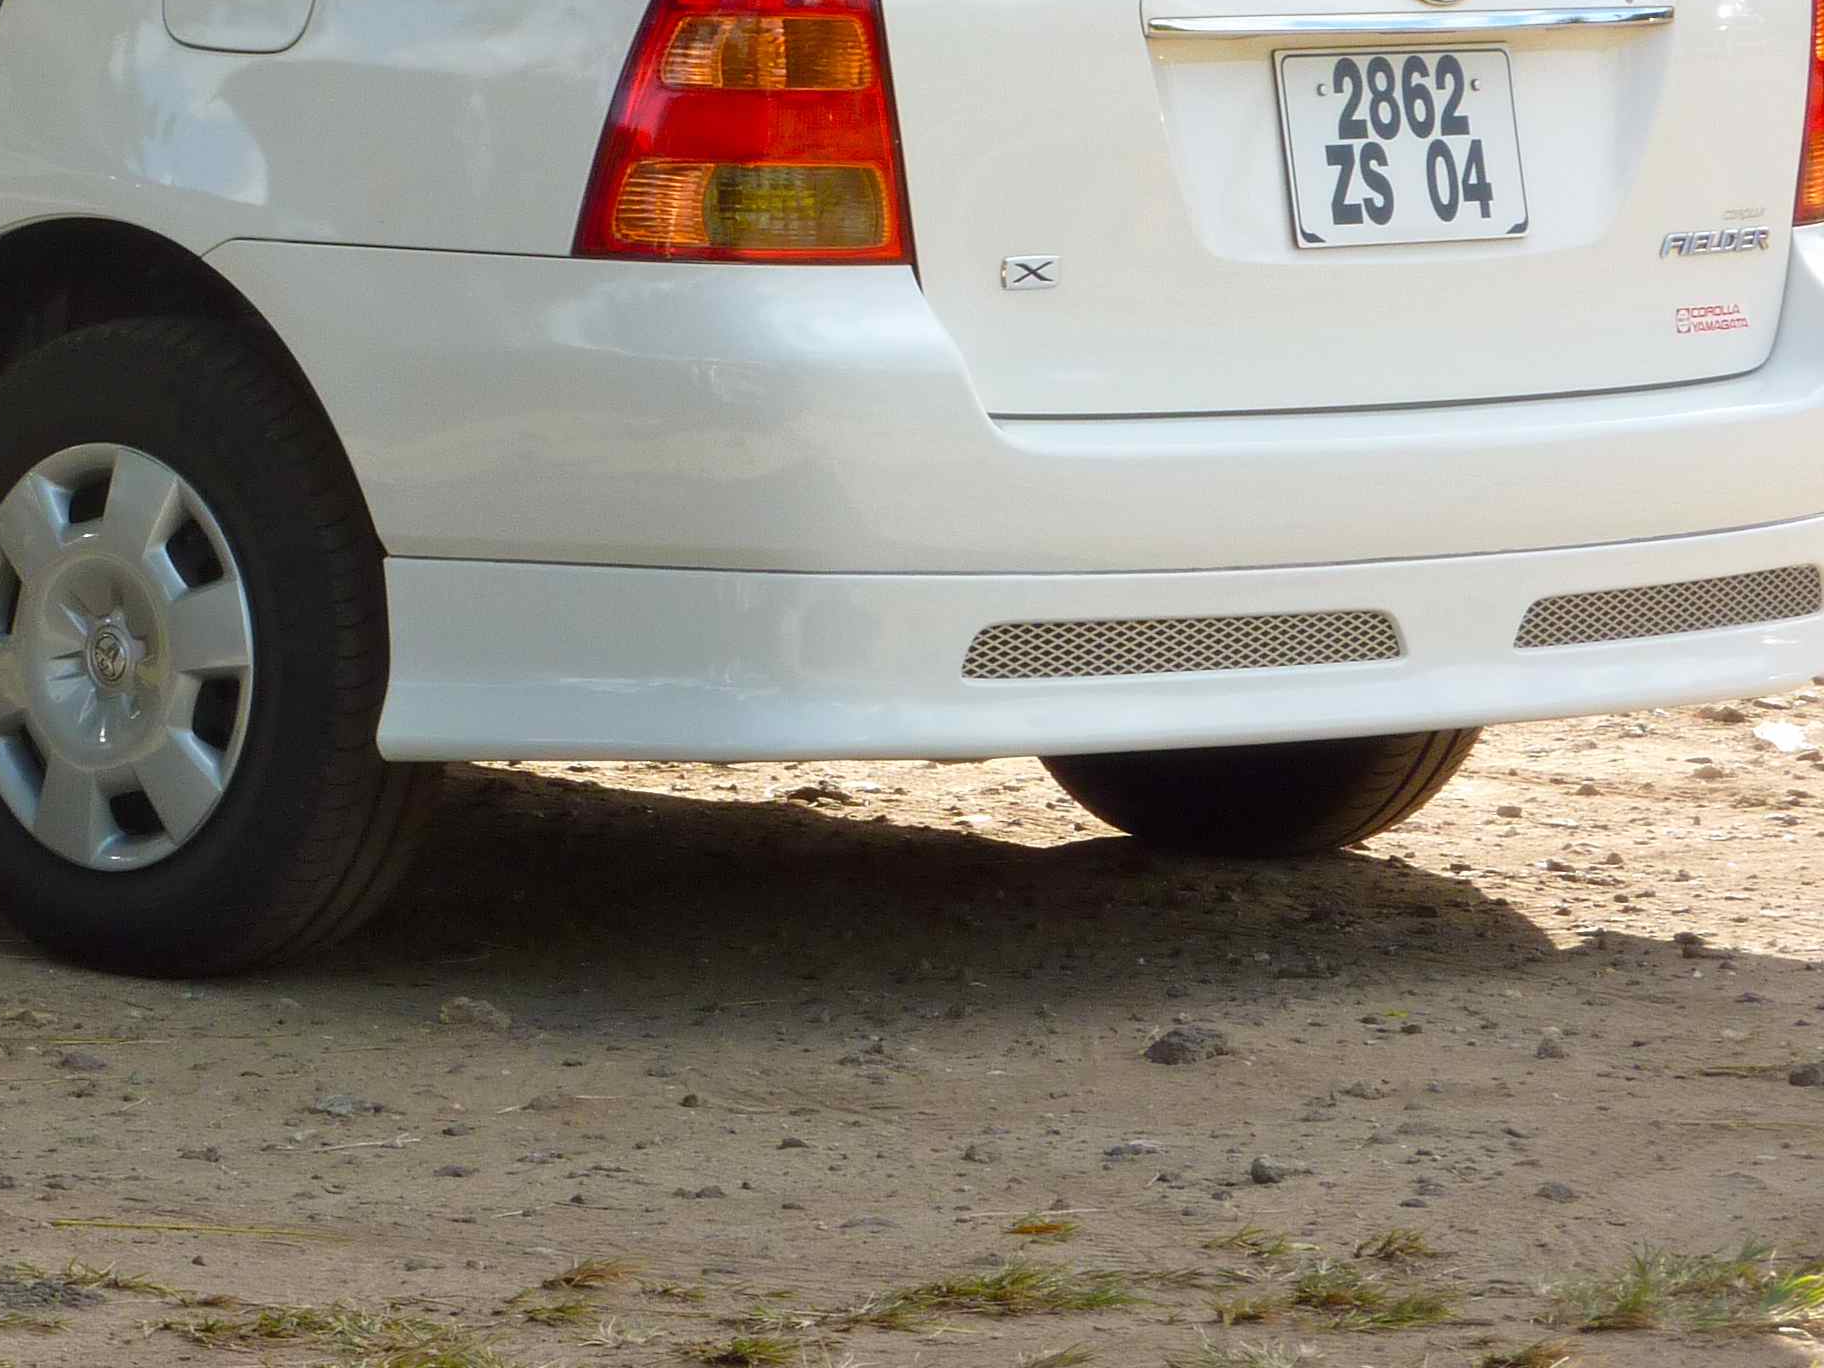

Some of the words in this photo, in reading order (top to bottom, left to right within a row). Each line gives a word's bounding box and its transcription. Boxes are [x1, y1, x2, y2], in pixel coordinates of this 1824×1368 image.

[1333, 55, 1470, 140] 2862
[1325, 141, 1394, 225] ZS
[1426, 139, 1493, 222] 04
[1659, 226, 1769, 259] FIELDER
[1691, 304, 1740, 318] COROLLA
[1692, 318, 1749, 332] YAMAGATA
